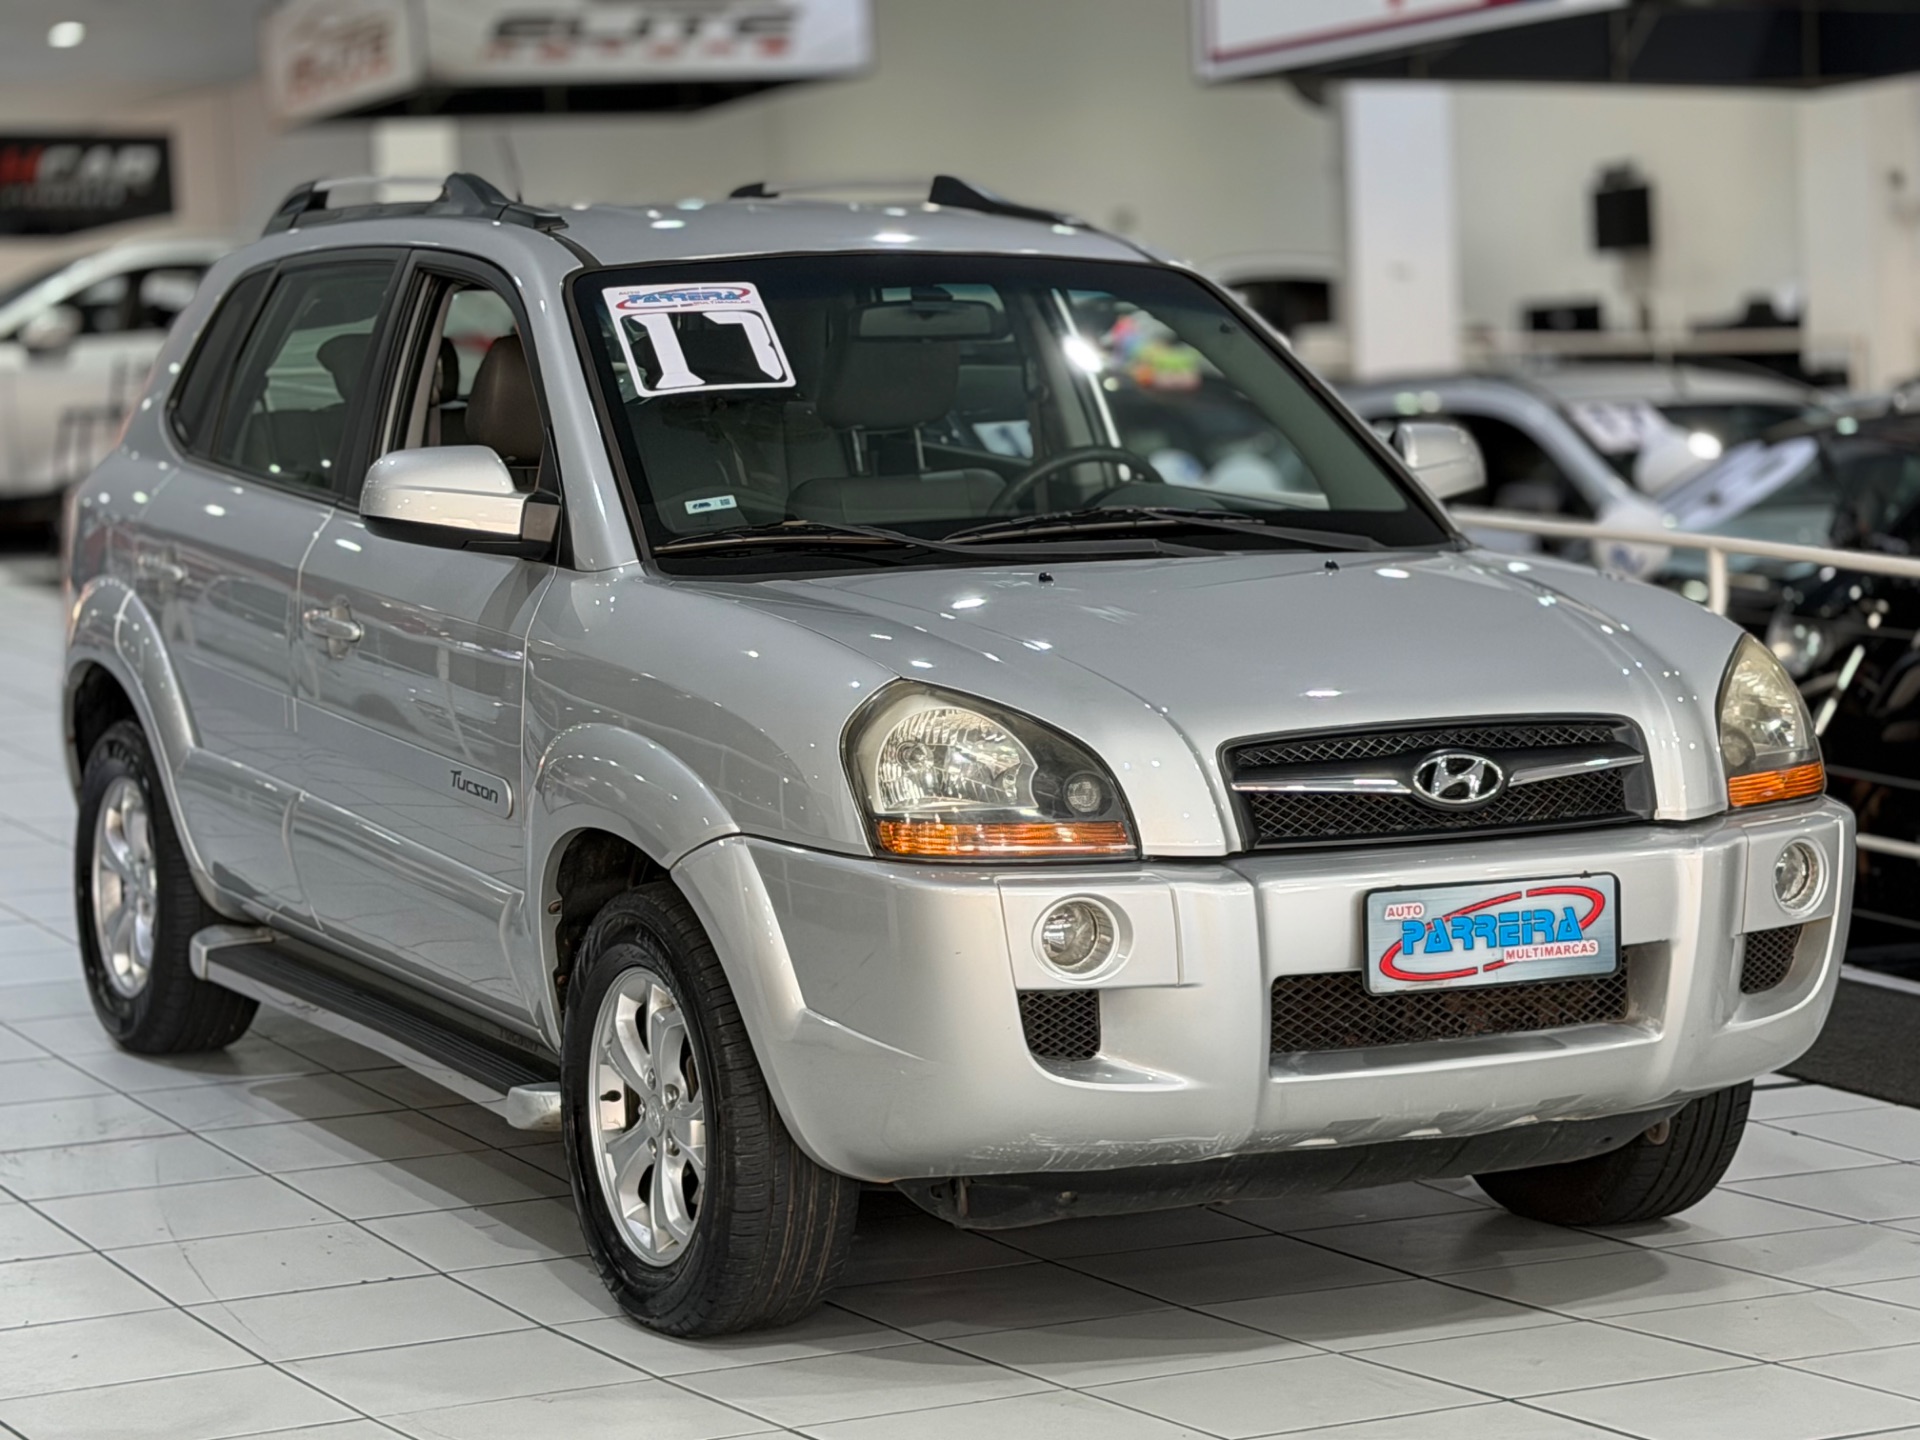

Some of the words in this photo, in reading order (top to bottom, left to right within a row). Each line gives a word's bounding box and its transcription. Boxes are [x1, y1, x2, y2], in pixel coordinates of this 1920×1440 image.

[450, 769, 498, 804] Tucson
[1387, 904, 1423, 918] AUTO
[1402, 906, 1583, 955] PARREIRA
[1505, 942, 1597, 960] MULTIMARCAS
